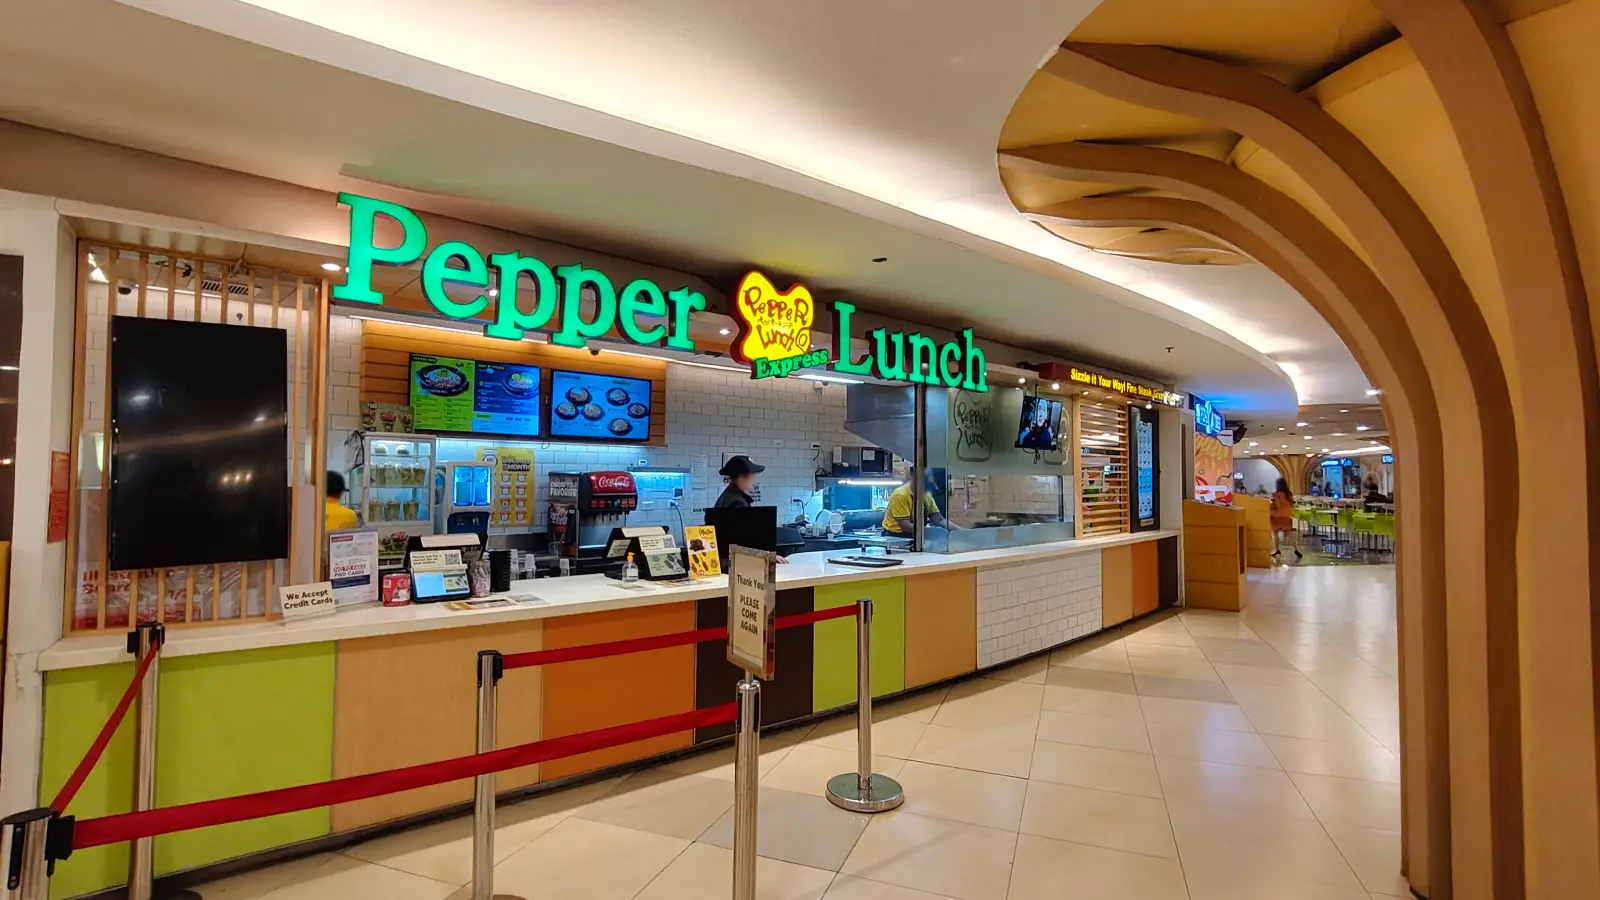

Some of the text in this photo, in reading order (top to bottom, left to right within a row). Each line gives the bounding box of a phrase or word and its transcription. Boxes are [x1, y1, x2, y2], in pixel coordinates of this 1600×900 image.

[332, 191, 706, 351] Pepper
[757, 324, 795, 352] Lunch
[834, 300, 989, 393] Lunch
[755, 349, 829, 379] Express
[1070, 368, 1091, 383] Sizzle
[1091, 373, 1097, 385] it
[1098, 374, 1112, 388] Your
[1112, 378, 1126, 393] Way!
[1126, 382, 1138, 394] Fine
[550, 488, 578, 497] FAVORITE
[737, 574, 765, 591] Thank You
[301, 589, 329, 599] Accept
[740, 594, 759, 609] PLEASE
[284, 597, 333, 609] Credit Cards
[741, 607, 757, 622] COME
[740, 620, 758, 636] AGAIN
